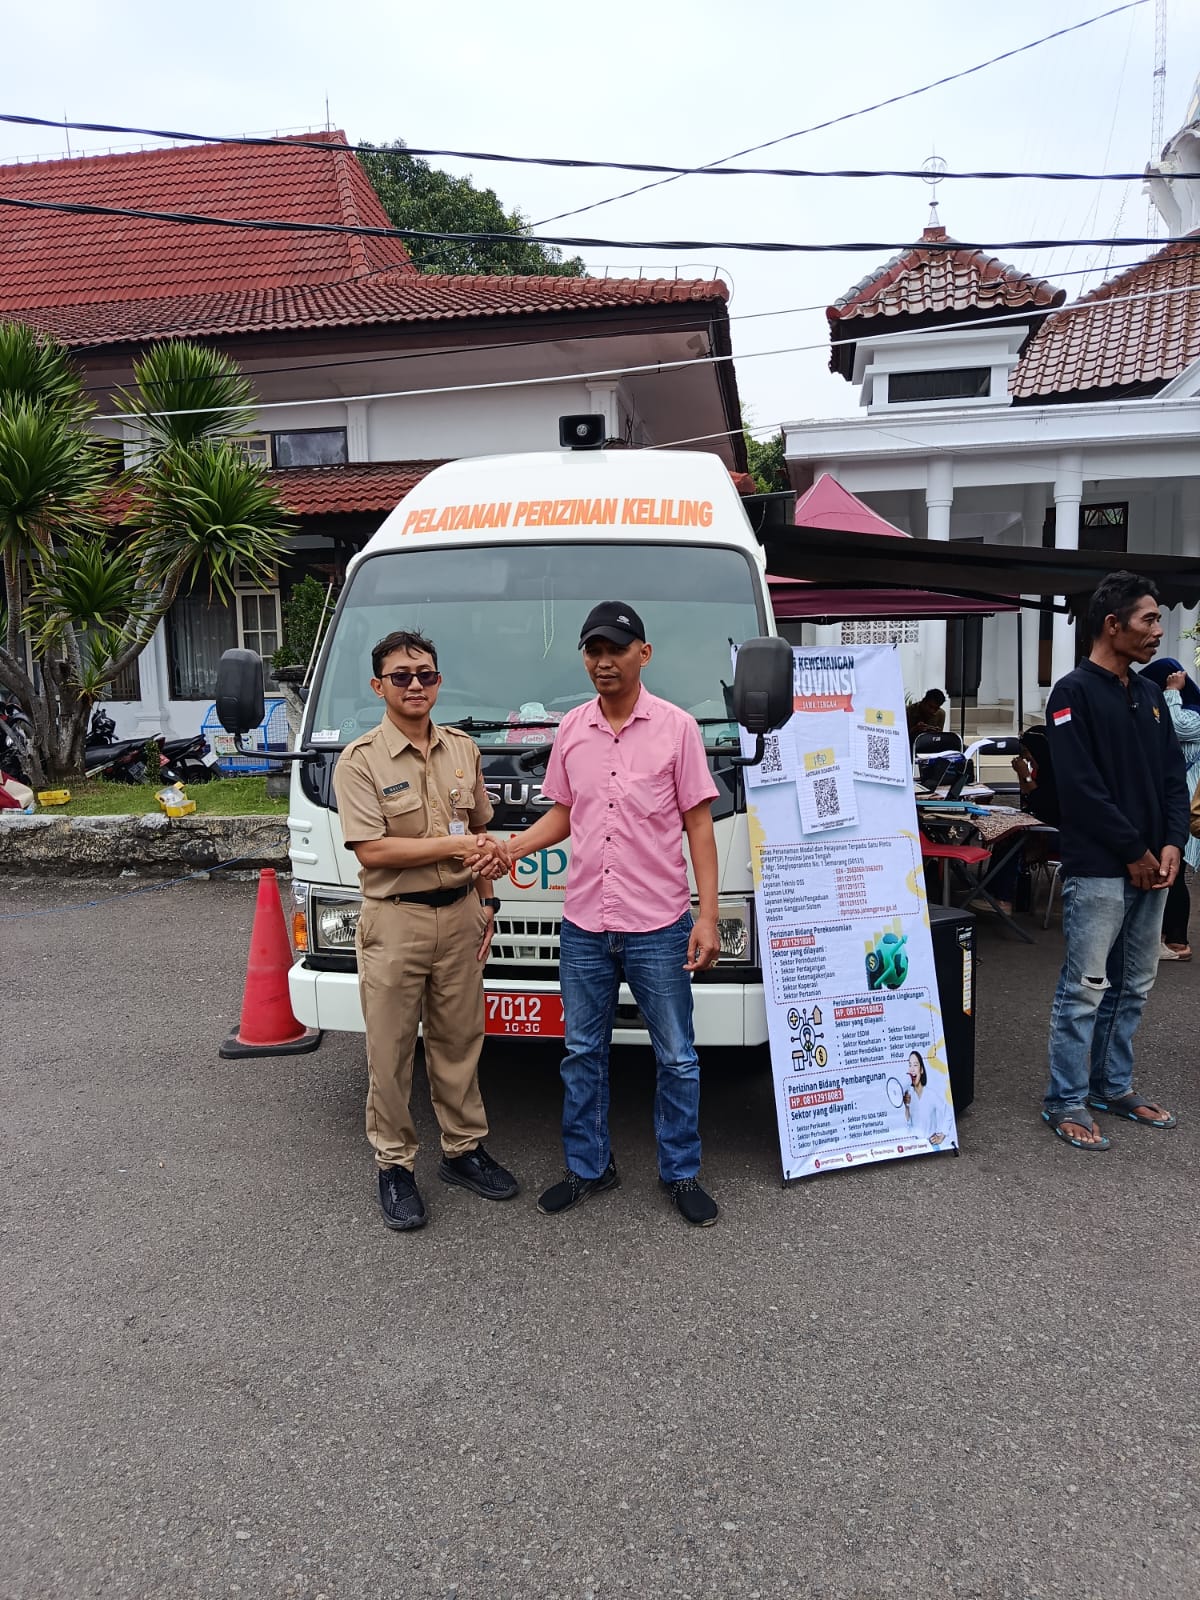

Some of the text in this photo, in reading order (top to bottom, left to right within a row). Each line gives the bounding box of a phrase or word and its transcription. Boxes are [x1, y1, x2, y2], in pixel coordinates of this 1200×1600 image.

[401, 498, 713, 535] PELAYANAN PERIZINAN KELILING
[798, 656, 854, 671] KEWENANGAN
[793, 669, 857, 696] ROVINSI
[484, 784, 557, 805] SUZ
[824, 844, 848, 854] Pelayanan
[848, 843, 867, 852] Terpadu
[784, 854, 802, 862] Provinsi
[802, 854, 814, 862] Jawa
[815, 852, 832, 862] Tengah
[824, 860, 847, 868] Semarang
[762, 882, 781, 890] Layanan
[782, 880, 796, 888] Teknis
[764, 890, 782, 898] Layanan
[764, 898, 782, 906] Layanan
[766, 906, 783, 915] Layanan
[784, 904, 806, 913] Gangguan
[766, 914, 784, 922] Website
[770, 924, 852, 938] Perizinan Bidang Perekonomian
[772, 950, 788, 958] Sektor
[790, 948, 802, 958] yang
[803, 945, 824, 956] dilayani
[780, 956, 827, 966] Sektor Perindustrian
[780, 964, 826, 975] Sektor Perdagangan
[782, 972, 836, 983] Sektor Ketenagakerjaan
[782, 981, 818, 992] Sektor Koperasi
[784, 990, 822, 1000] Sektor Pertanian
[832, 991, 924, 1007] Perizinan Bidang Kesra dan Lingkungan
[486, 995, 542, 1021] 7012
[834, 1019, 850, 1028] Sektor
[852, 1018, 864, 1028] yang
[864, 1016, 883, 1026] dilayani
[888, 1026, 902, 1034] Sektor
[842, 1032, 856, 1040] Sektor
[888, 1034, 904, 1042] Sektor
[842, 1038, 882, 1049] Sektor Kesehatan
[890, 1040, 930, 1050] Sektor Lingkungan
[858, 1046, 884, 1055] Pendidikan
[860, 1055, 884, 1064] Kehutanan
[890, 1052, 904, 1060] Hidup
[788, 1072, 886, 1094] Perizinan Bidang Pembangunan
[790, 1097, 802, 1107] HP.
[790, 1110, 811, 1121] Sektor
[812, 1107, 828, 1119] yang
[828, 1101, 853, 1114] dilayani
[848, 1116, 860, 1124] Sektor
[796, 1125, 810, 1133] Sektor
[848, 1124, 862, 1132] Sektor
[797, 1128, 838, 1142] Sektor Perhubungan
[850, 1132, 862, 1140] Sektor
[798, 1142, 811, 1150] Sektor
